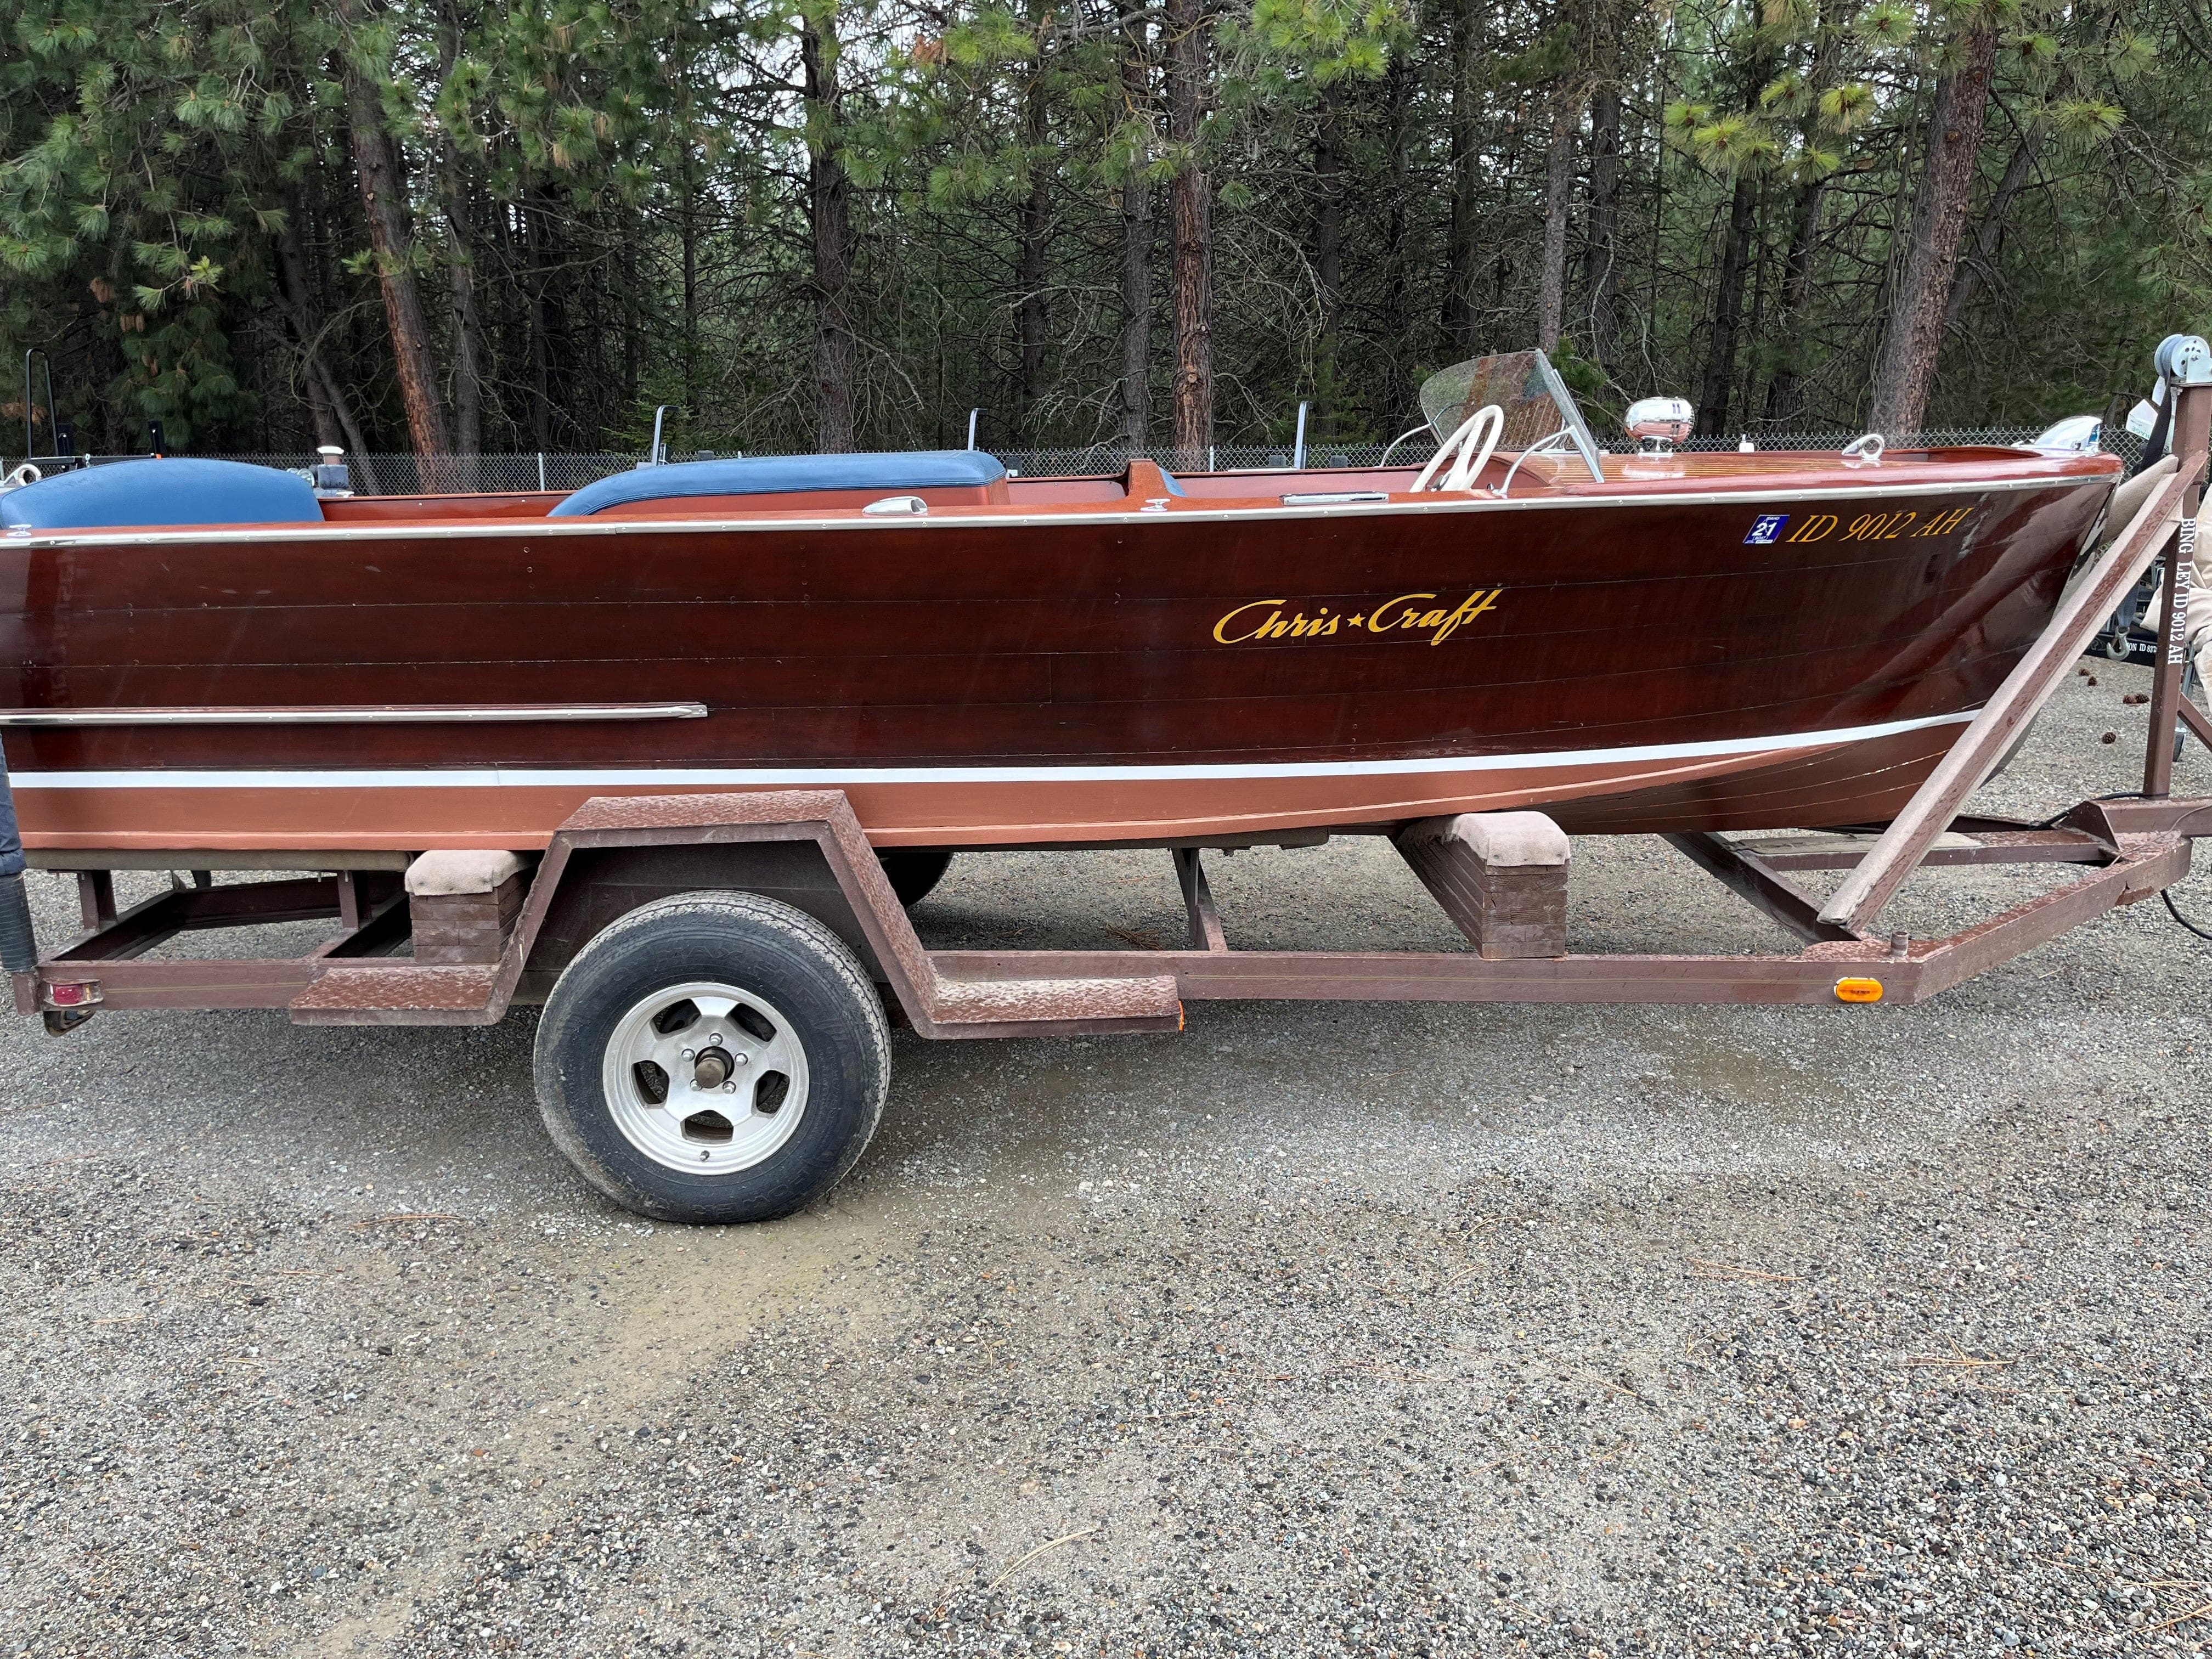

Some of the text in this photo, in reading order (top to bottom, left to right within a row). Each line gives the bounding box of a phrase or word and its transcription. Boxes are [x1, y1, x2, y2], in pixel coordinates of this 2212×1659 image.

[1752, 522, 1777, 536] 21
[1785, 507, 1974, 543] ID 9012 AH
[2167, 517, 2196, 665] BING LEY ID 9012 AH
[1213, 589, 1503, 646] Chris Craft
[2139, 644, 2146, 652] ID
